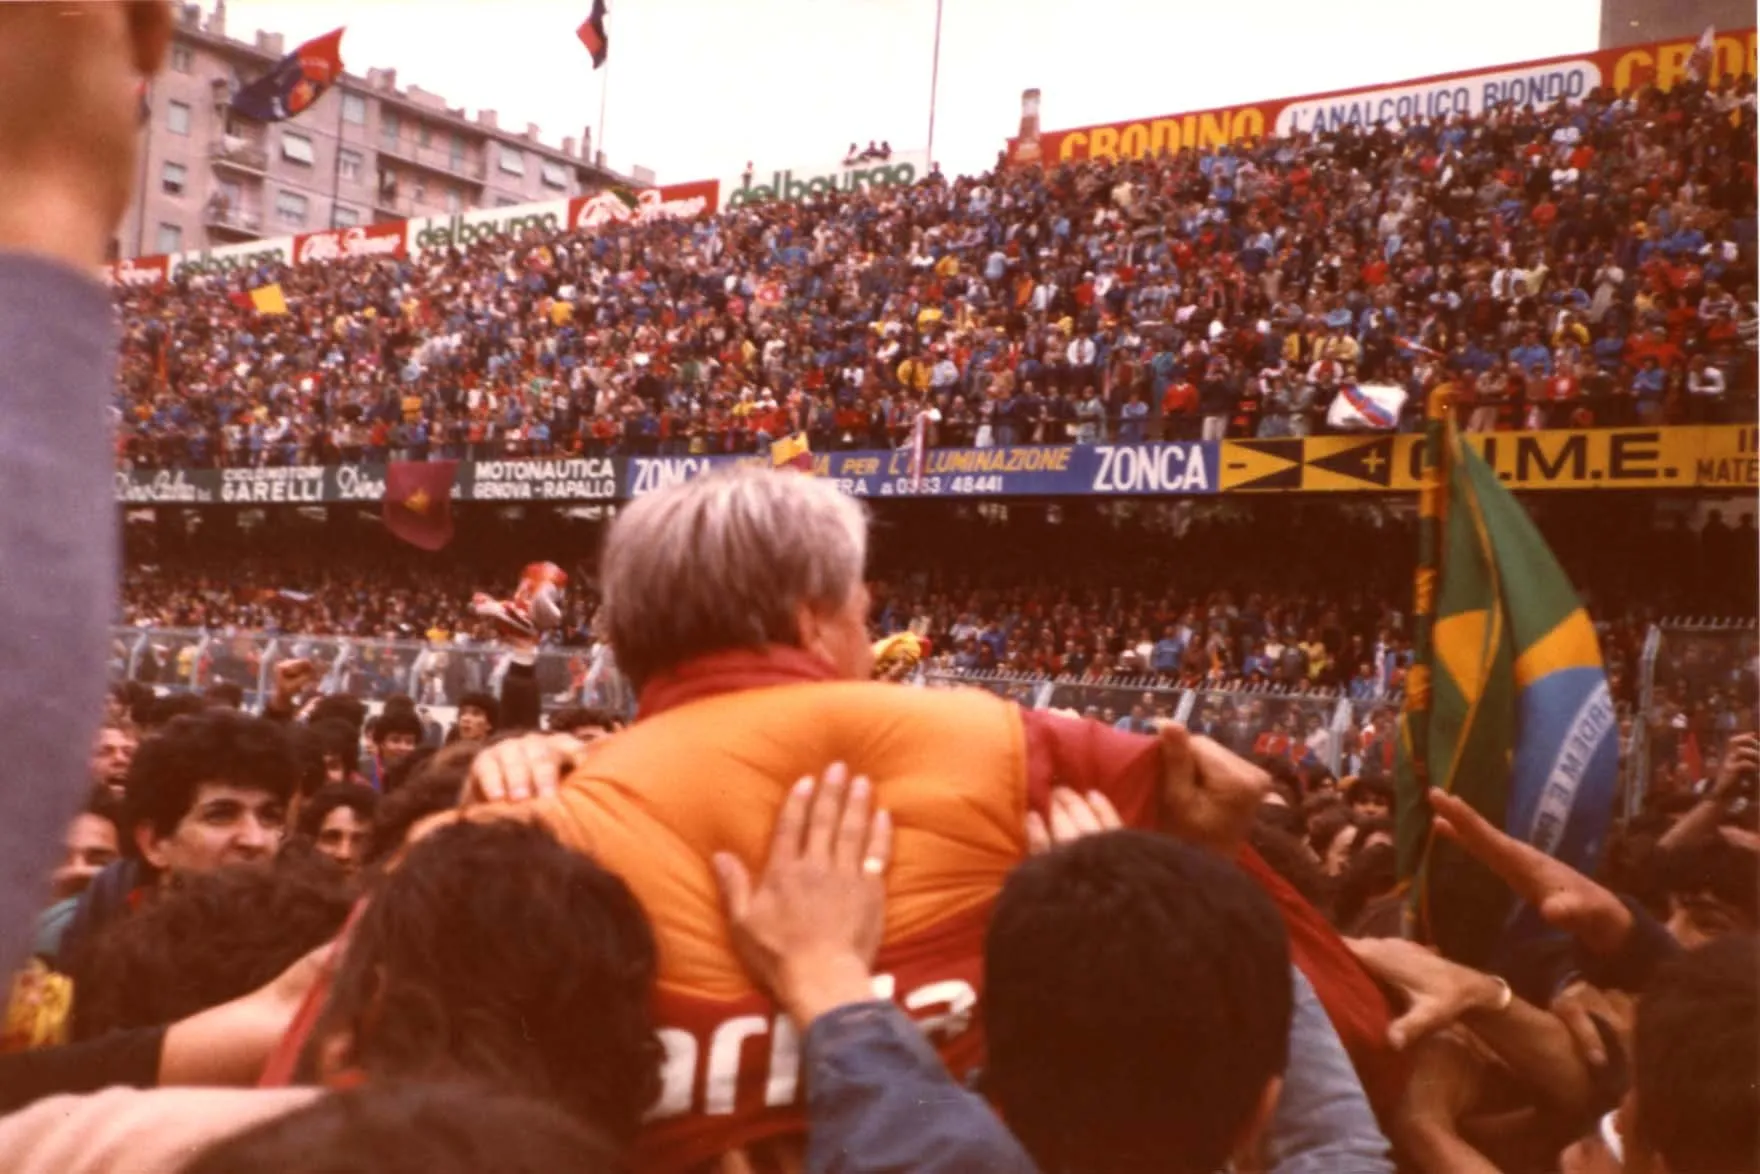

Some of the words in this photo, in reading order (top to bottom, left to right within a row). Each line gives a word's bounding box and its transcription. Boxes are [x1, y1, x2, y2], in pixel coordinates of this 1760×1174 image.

[1483, 69, 1585, 110] BIONDO
[1059, 107, 1265, 166] CRODINO
[475, 457, 615, 480] MOTONAUTICA
[841, 456, 880, 475] PER
[1093, 445, 1208, 492] ZONCA
[221, 480, 325, 502] GARELLI
[543, 479, 616, 499] RAPALLO
